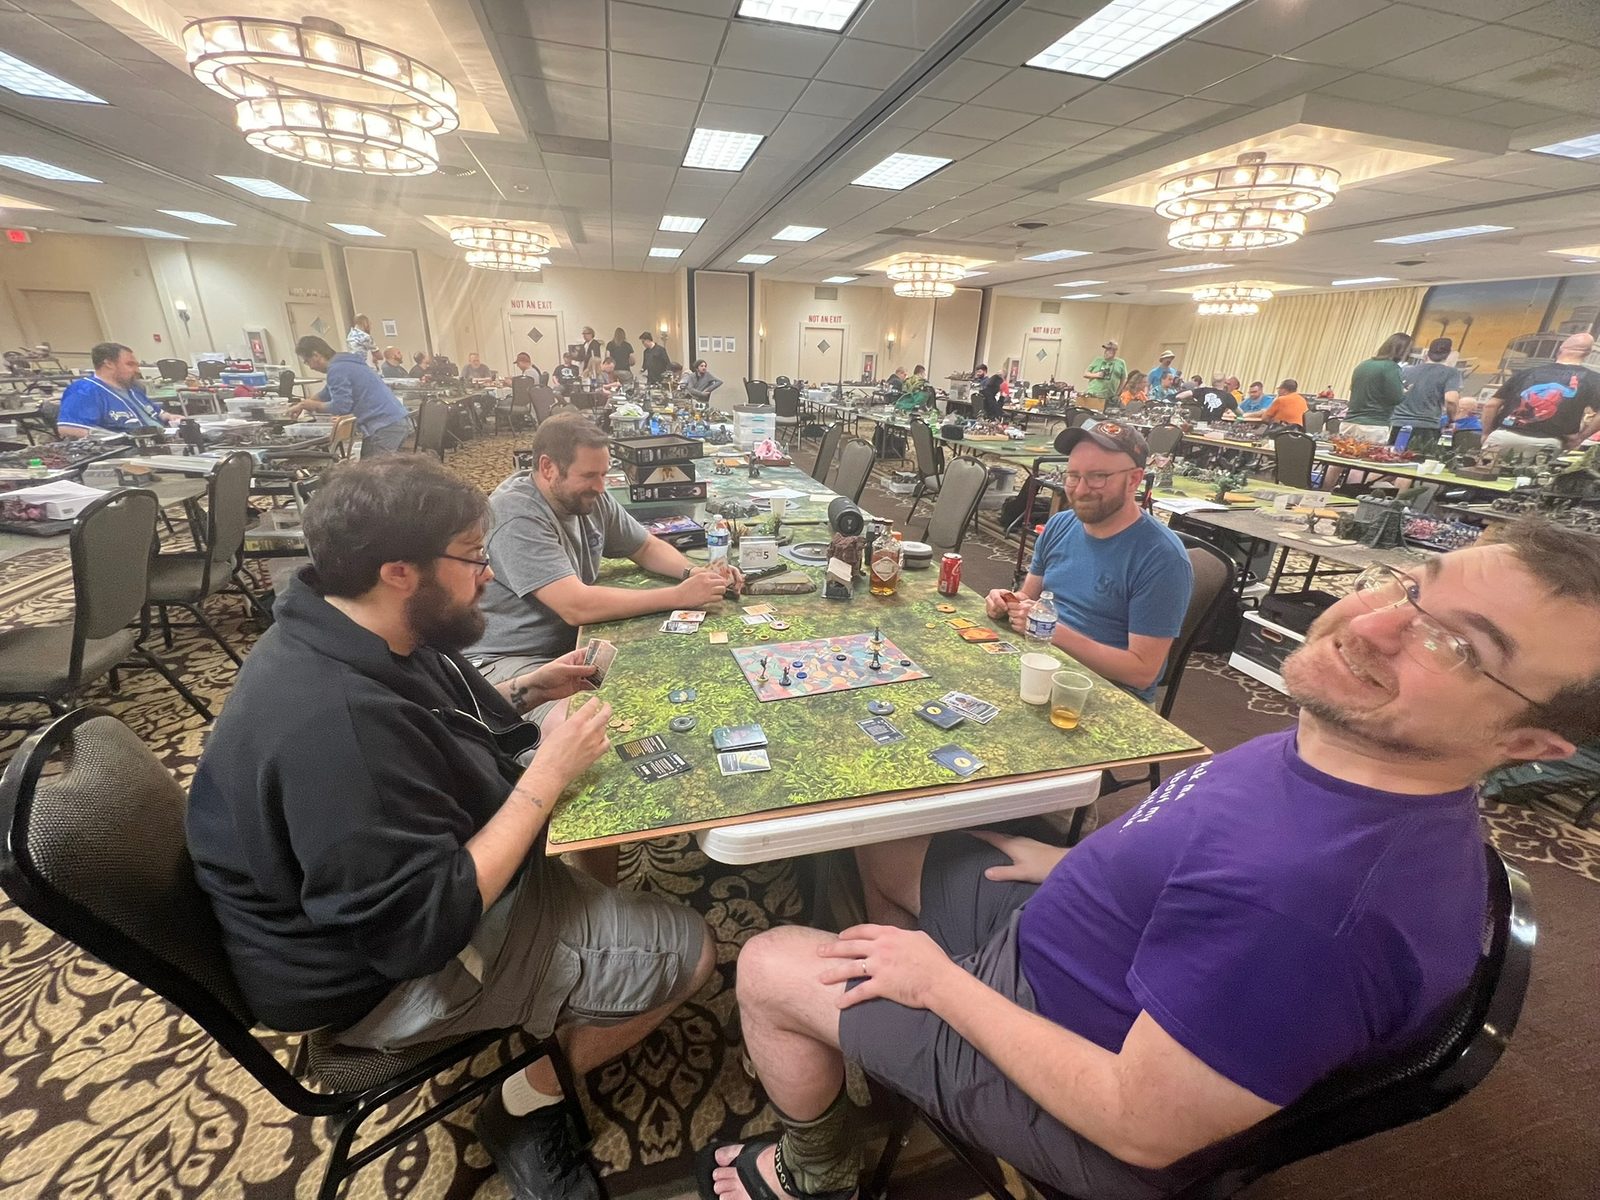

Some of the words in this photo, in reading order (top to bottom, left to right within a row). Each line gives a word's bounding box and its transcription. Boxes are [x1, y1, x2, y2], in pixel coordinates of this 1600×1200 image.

[511, 299, 524, 309] NOT
[526, 300, 536, 310] AN
[537, 300, 552, 310] EXIT
[808, 315, 819, 323] NOT
[820, 315, 829, 323] AN
[829, 315, 842, 324] EXIT
[1032, 326, 1043, 334] NOT
[1050, 327, 1062, 335] EXIT
[763, 551, 769, 560] 5
[1188, 760, 1213, 782] Ask
